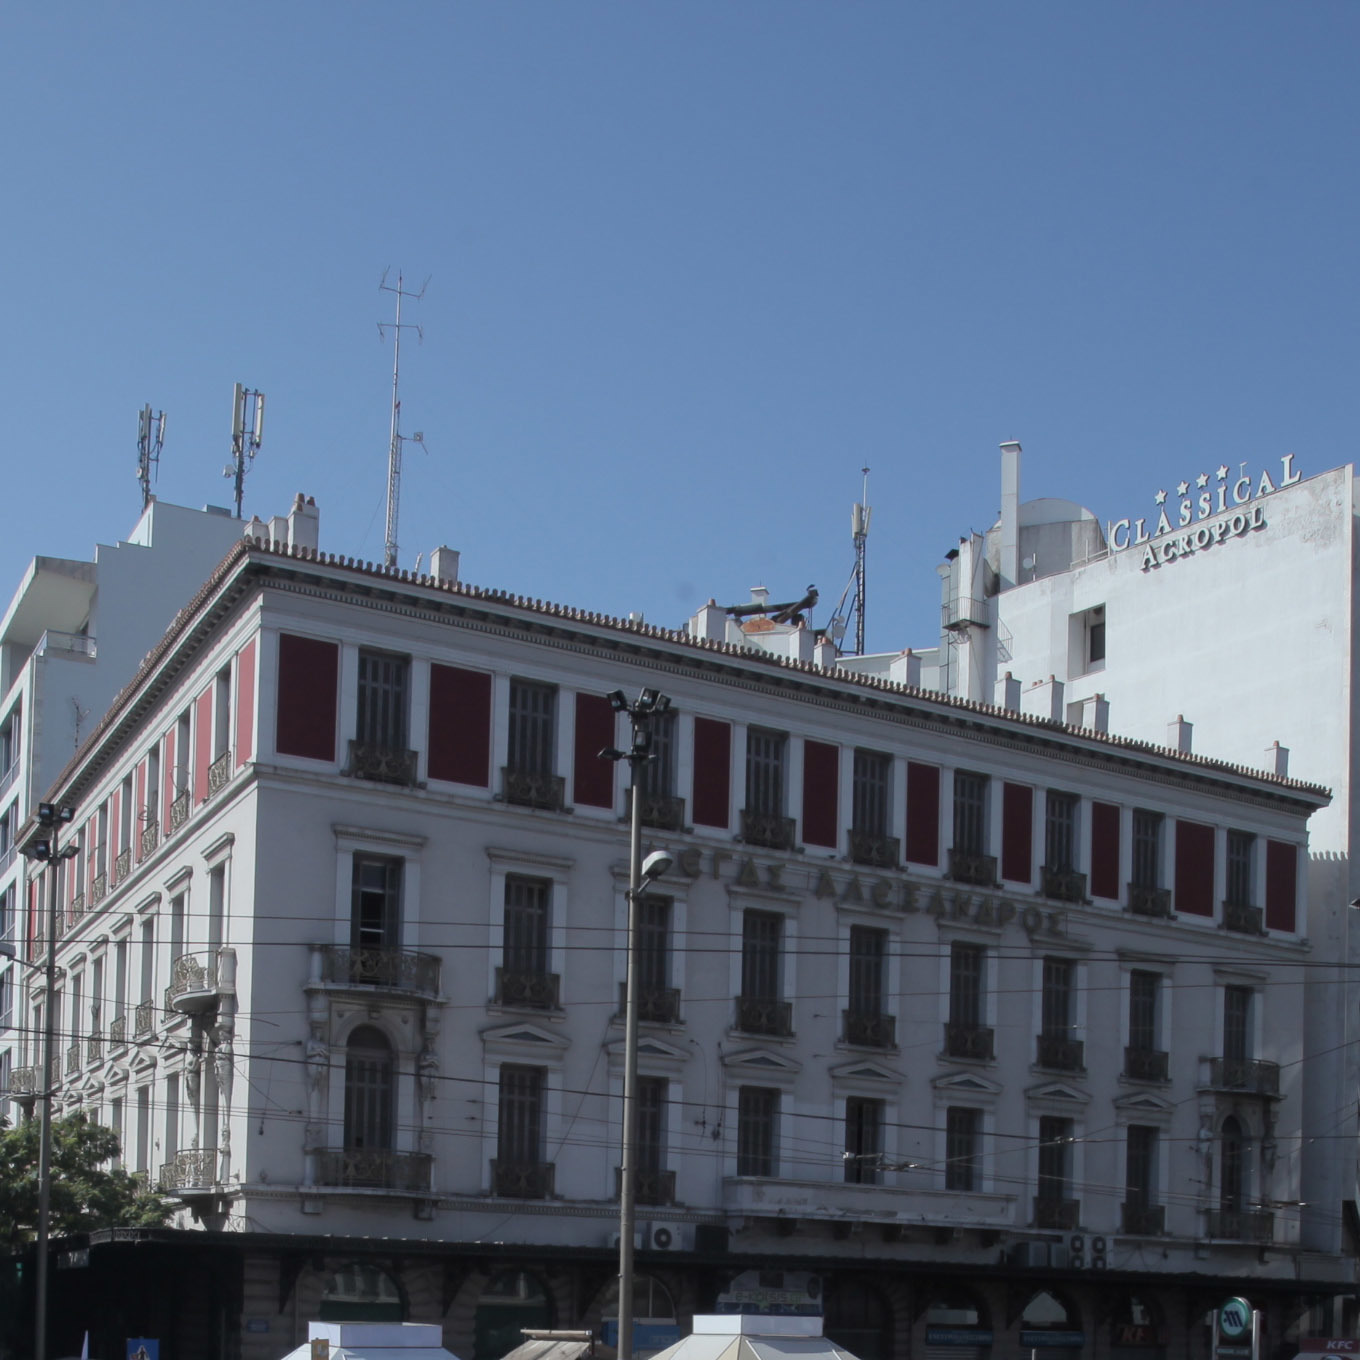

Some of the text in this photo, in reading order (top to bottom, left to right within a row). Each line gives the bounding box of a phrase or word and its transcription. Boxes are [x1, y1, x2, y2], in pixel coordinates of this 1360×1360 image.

[1110, 454, 1301, 551] CLASSICAL
[1141, 506, 1267, 570] ACROPOL
[648, 841, 787, 891] ΕΓΑΣ
[1326, 1340, 1354, 1350] KFC
